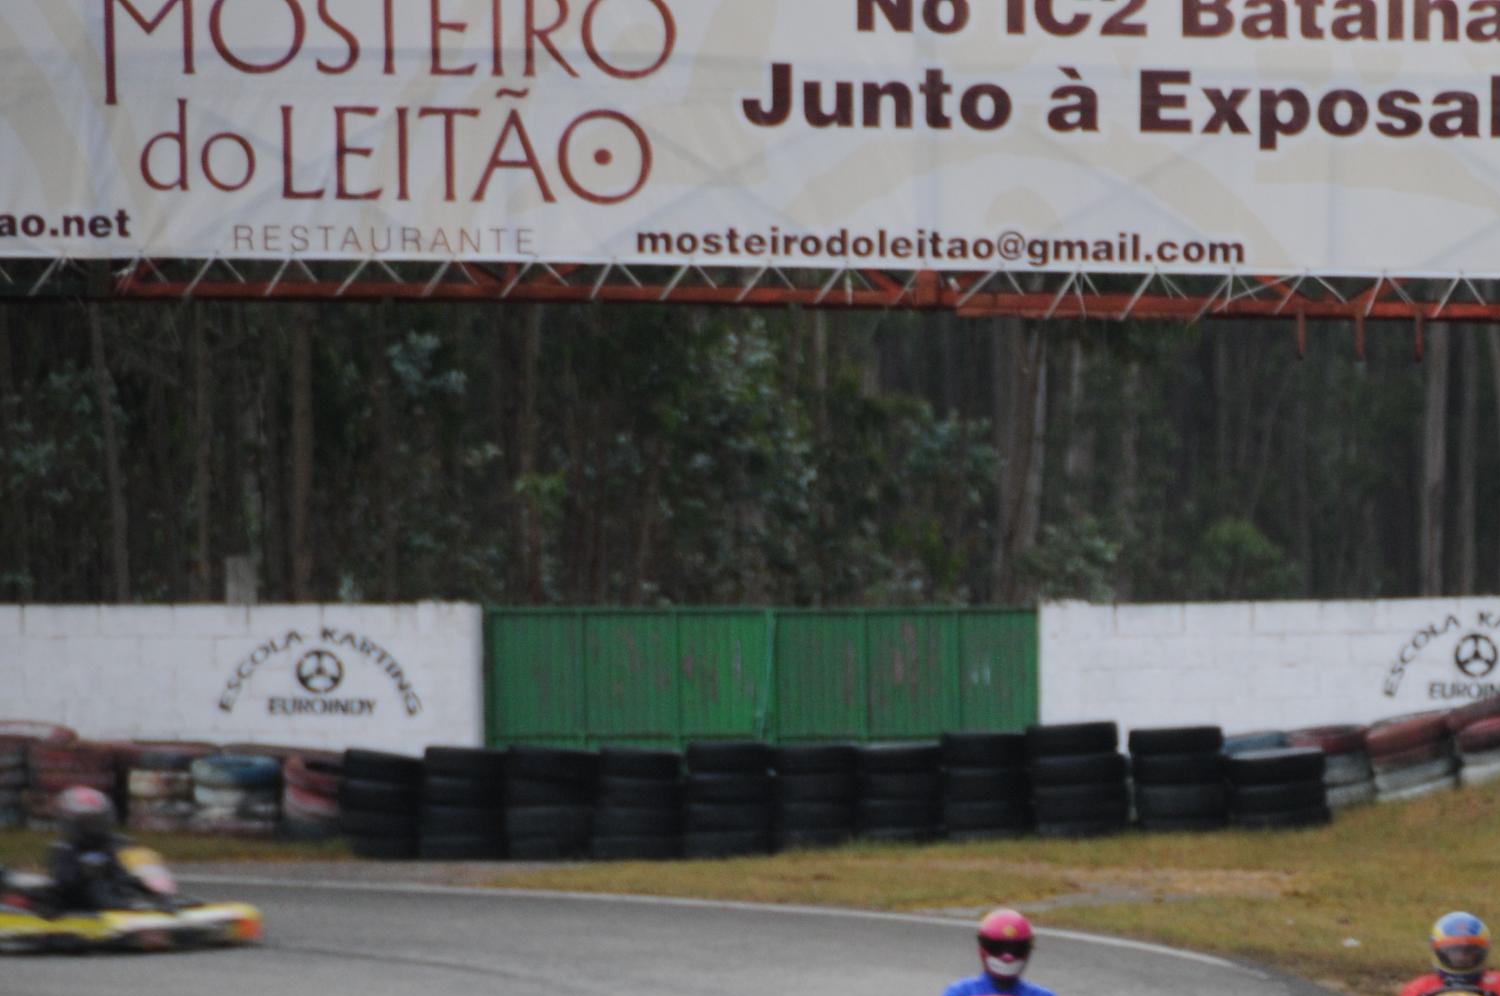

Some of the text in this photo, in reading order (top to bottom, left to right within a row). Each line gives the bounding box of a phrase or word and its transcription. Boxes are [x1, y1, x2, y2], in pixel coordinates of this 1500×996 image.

[855, 0, 970, 34] No
[1005, 0, 1148, 36] IC2
[102, 0, 677, 105] MOSTEIRO
[742, 62, 1013, 133] Junto
[1047, 66, 1099, 133] à
[139, 88, 653, 205] do LEITÃO
[0, 209, 130, 238] ao.net
[232, 224, 536, 255] RESTAURANTE
[635, 226, 1245, 266] mosteirodoleitao@gmail.com
[218, 627, 423, 716] ESCOLA KARTING
[1383, 614, 1460, 697] ESCOLA
[267, 697, 376, 715] EUROINDY
